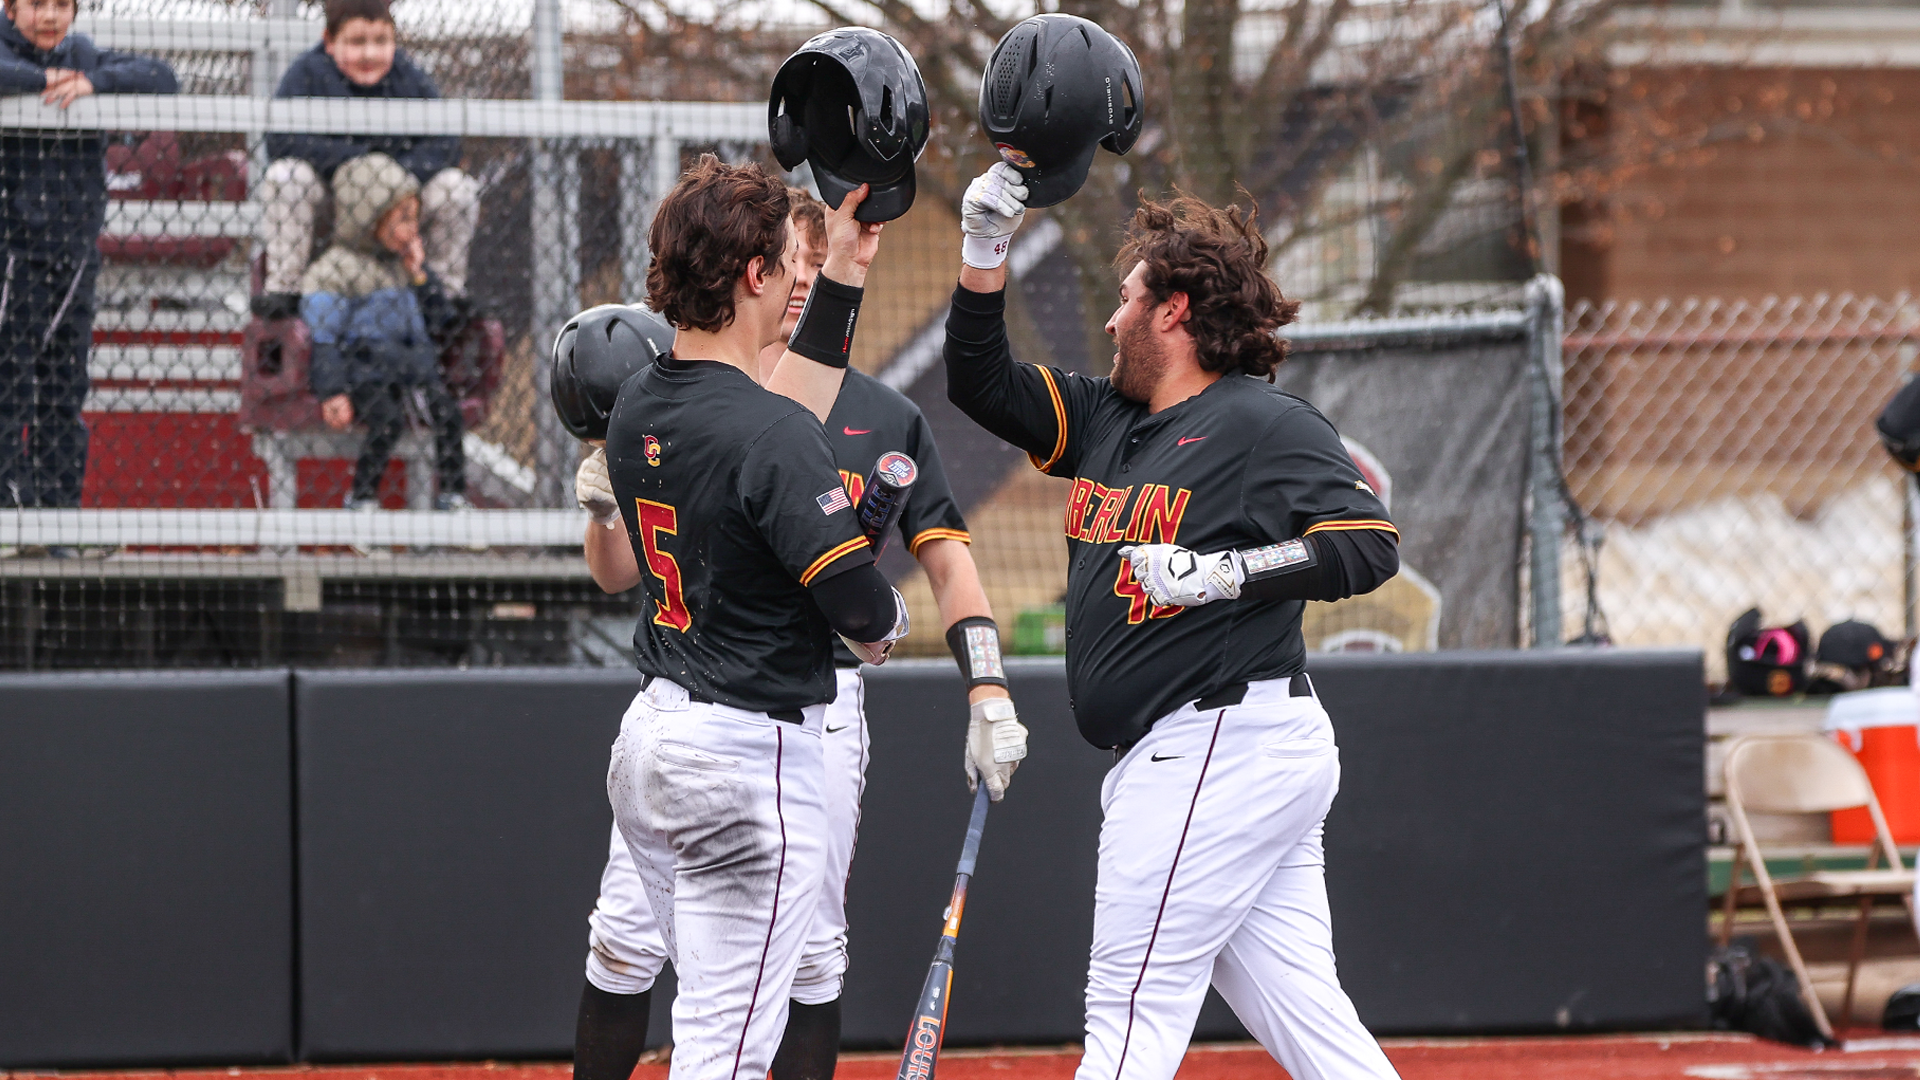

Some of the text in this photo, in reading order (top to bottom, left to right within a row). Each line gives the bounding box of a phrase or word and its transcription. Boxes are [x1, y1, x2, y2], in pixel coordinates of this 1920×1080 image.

[994, 240, 1008, 255] 48
[1065, 476, 1192, 545] BERLIN
[635, 497, 692, 634] 5
[1114, 556, 1186, 625] 4
